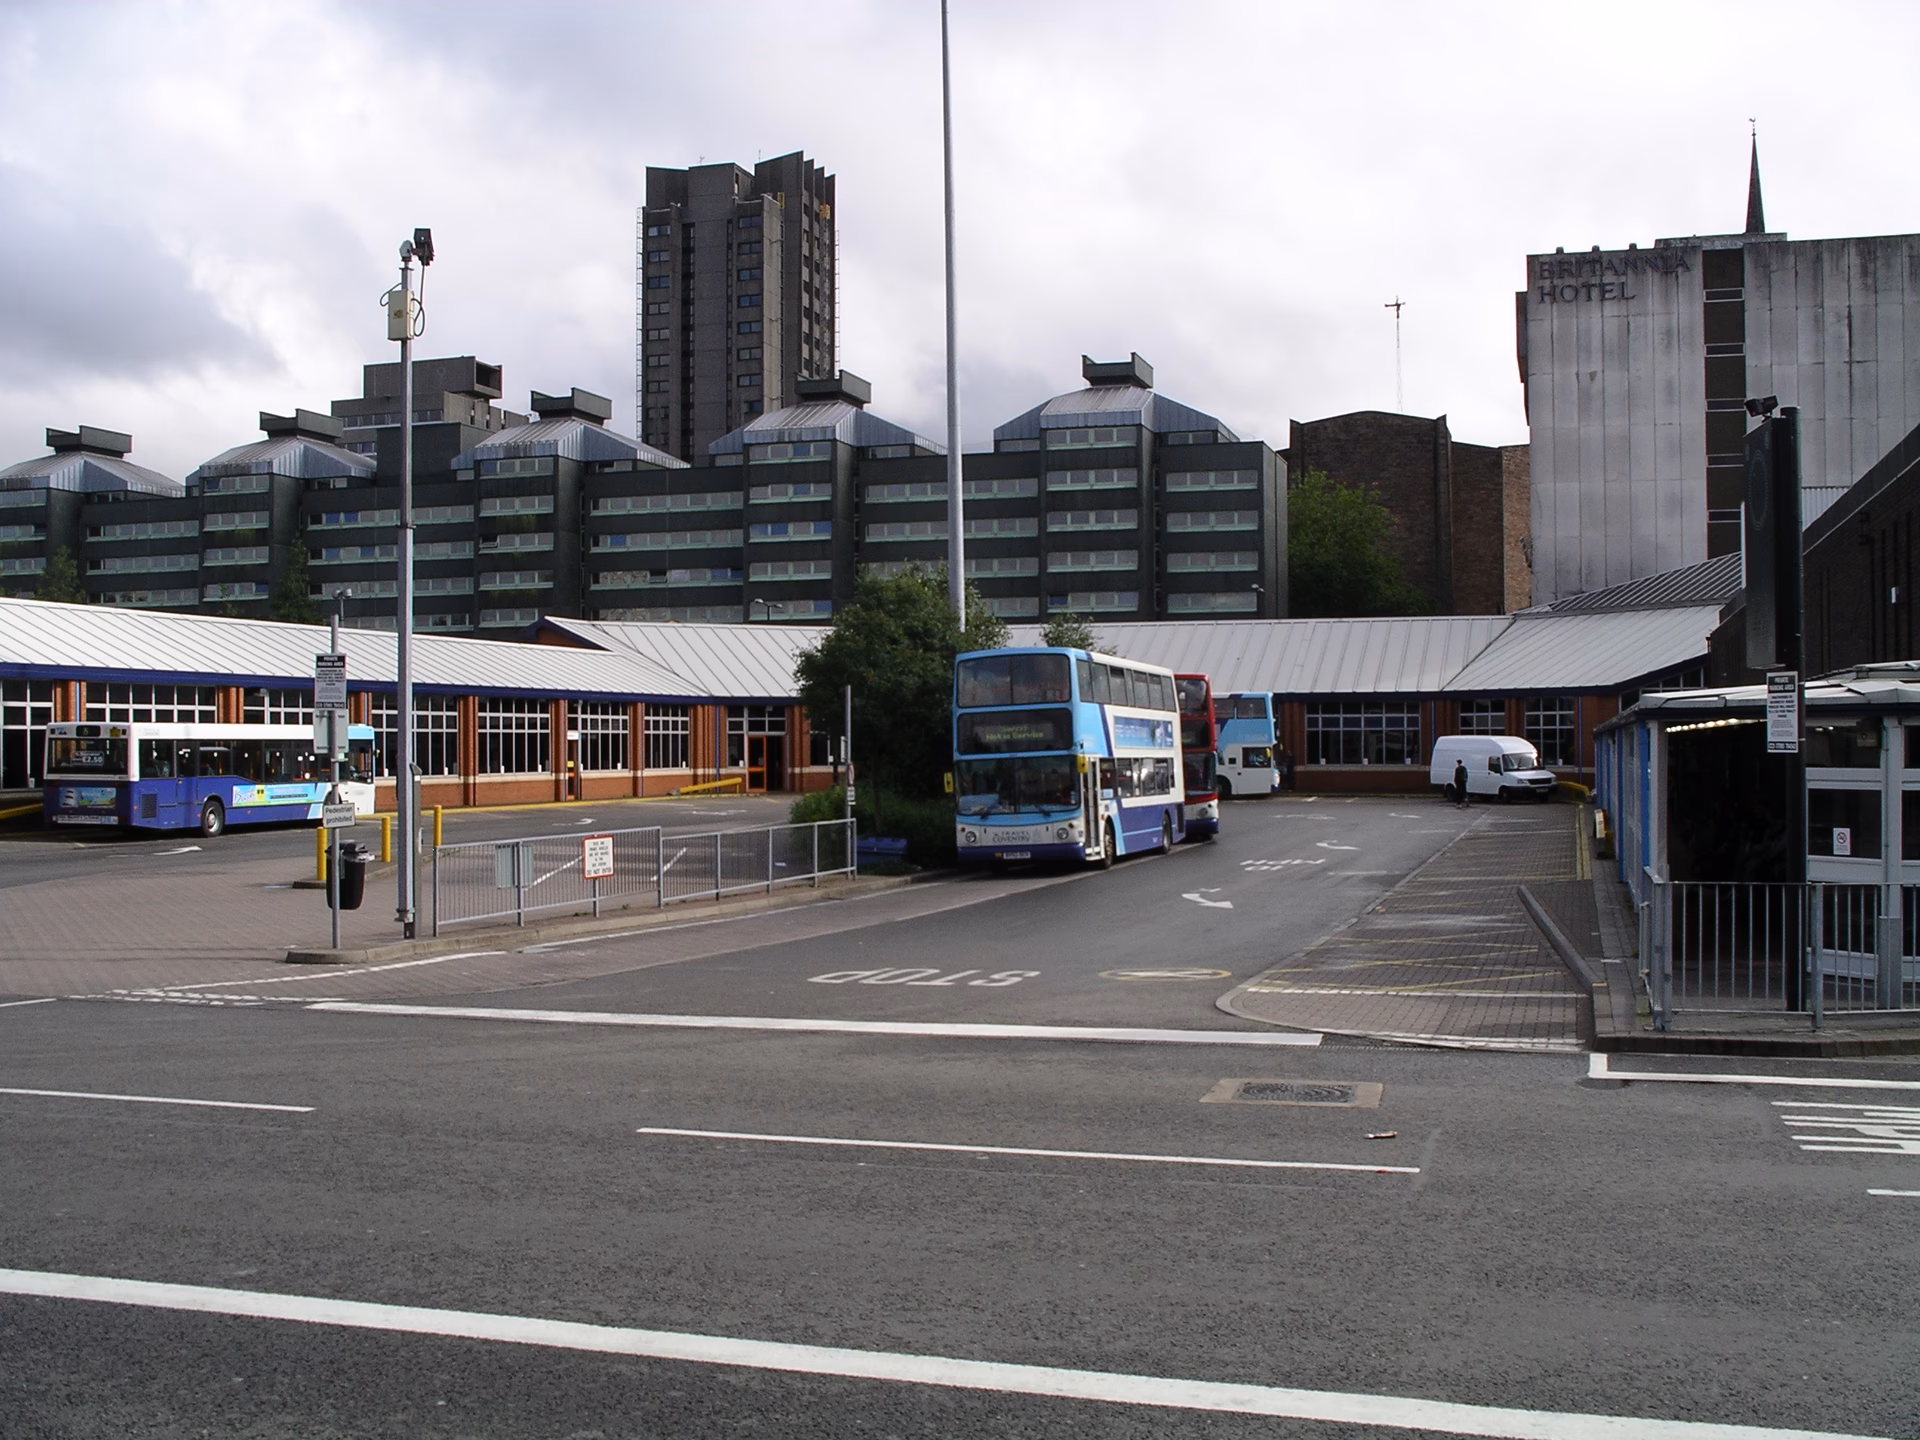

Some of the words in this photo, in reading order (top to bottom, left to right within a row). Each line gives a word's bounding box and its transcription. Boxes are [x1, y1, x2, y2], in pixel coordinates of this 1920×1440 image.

[1537, 254, 1691, 280] BRITANNIA
[1537, 281, 1636, 304] HOTEL
[325, 806, 352, 814] Pedestrian
[326, 816, 352, 825] prohibited
[807, 967, 1040, 987] STOP
